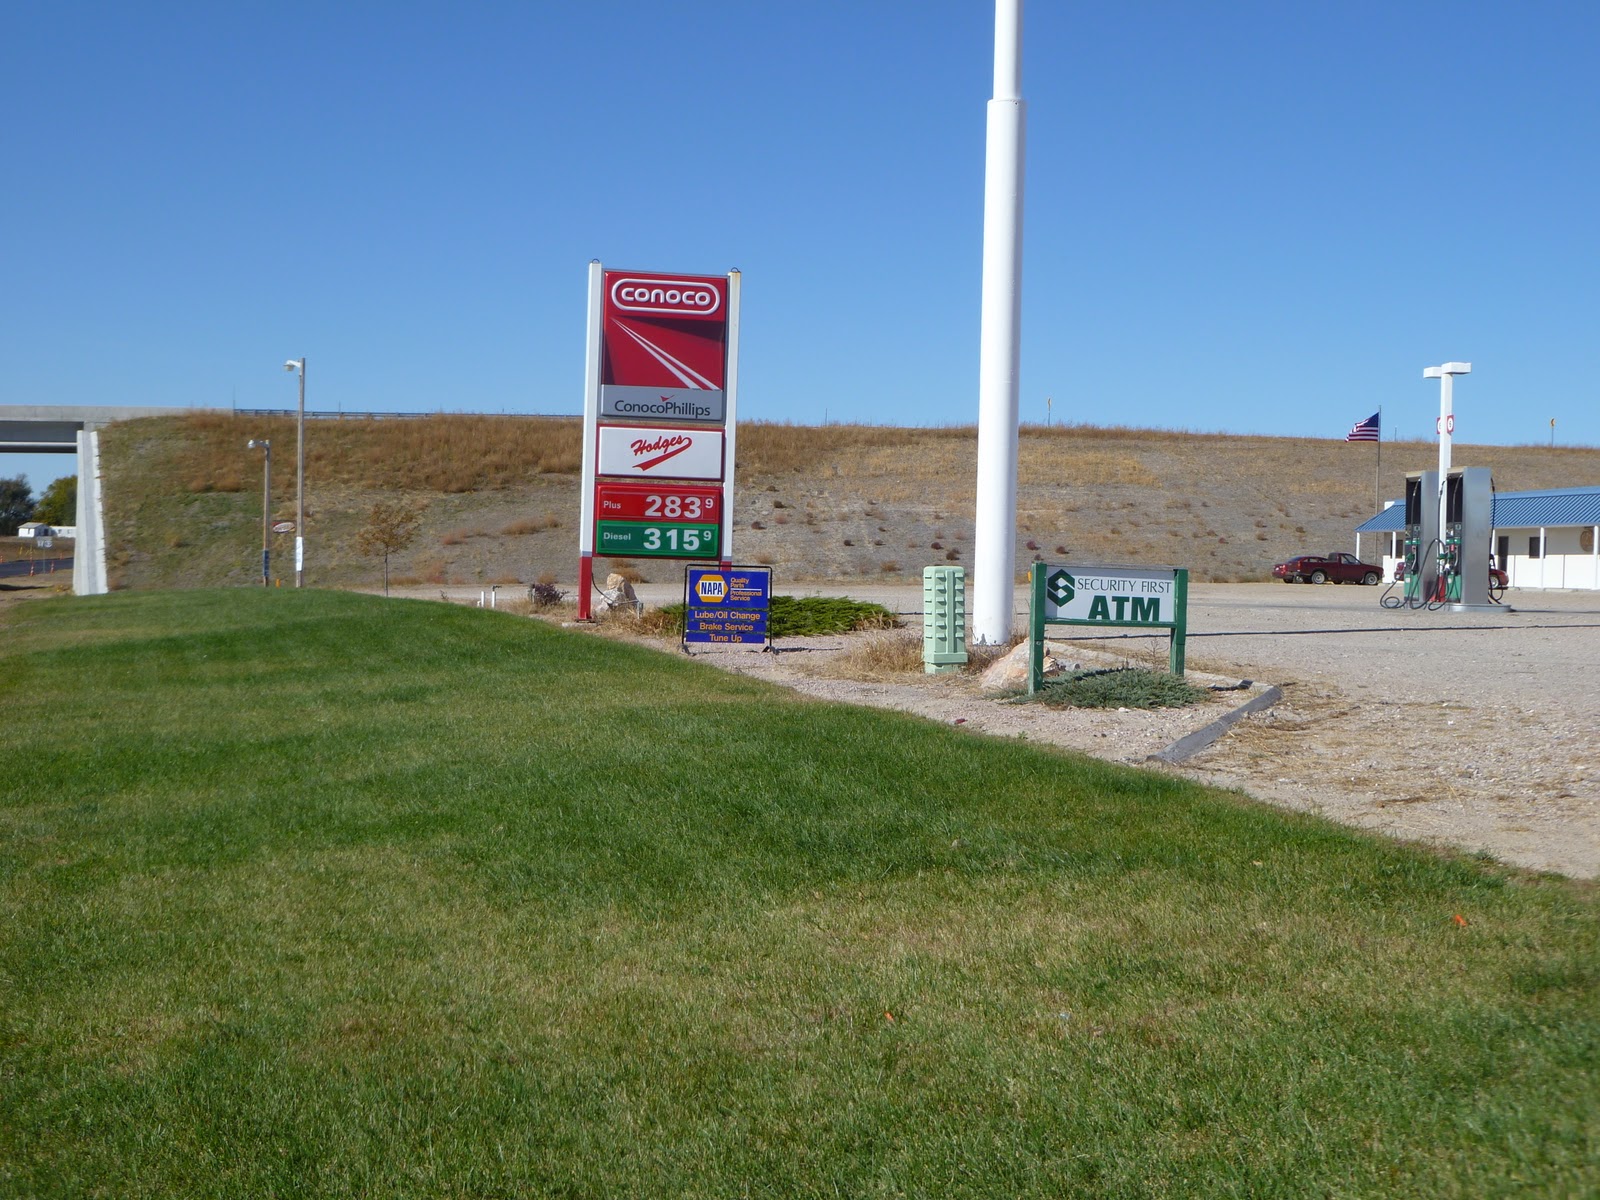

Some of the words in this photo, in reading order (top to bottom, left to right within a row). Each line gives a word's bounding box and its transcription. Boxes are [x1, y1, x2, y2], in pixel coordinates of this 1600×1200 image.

[614, 400, 711, 418] ConocoPhillips
[630, 435, 683, 456] Hodges
[603, 500, 622, 509] Plus
[644, 495, 701, 518] 283
[603, 532, 631, 540] Diesel
[643, 528, 700, 551] 315
[701, 582, 723, 595] NAPA
[1077, 578, 1137, 593] SECURITY
[1141, 580, 1172, 593] FIRST
[730, 612, 760, 620] Change
[1088, 595, 1160, 622] ATM
[724, 622, 754, 630] Service
[731, 635, 742, 643] Up
